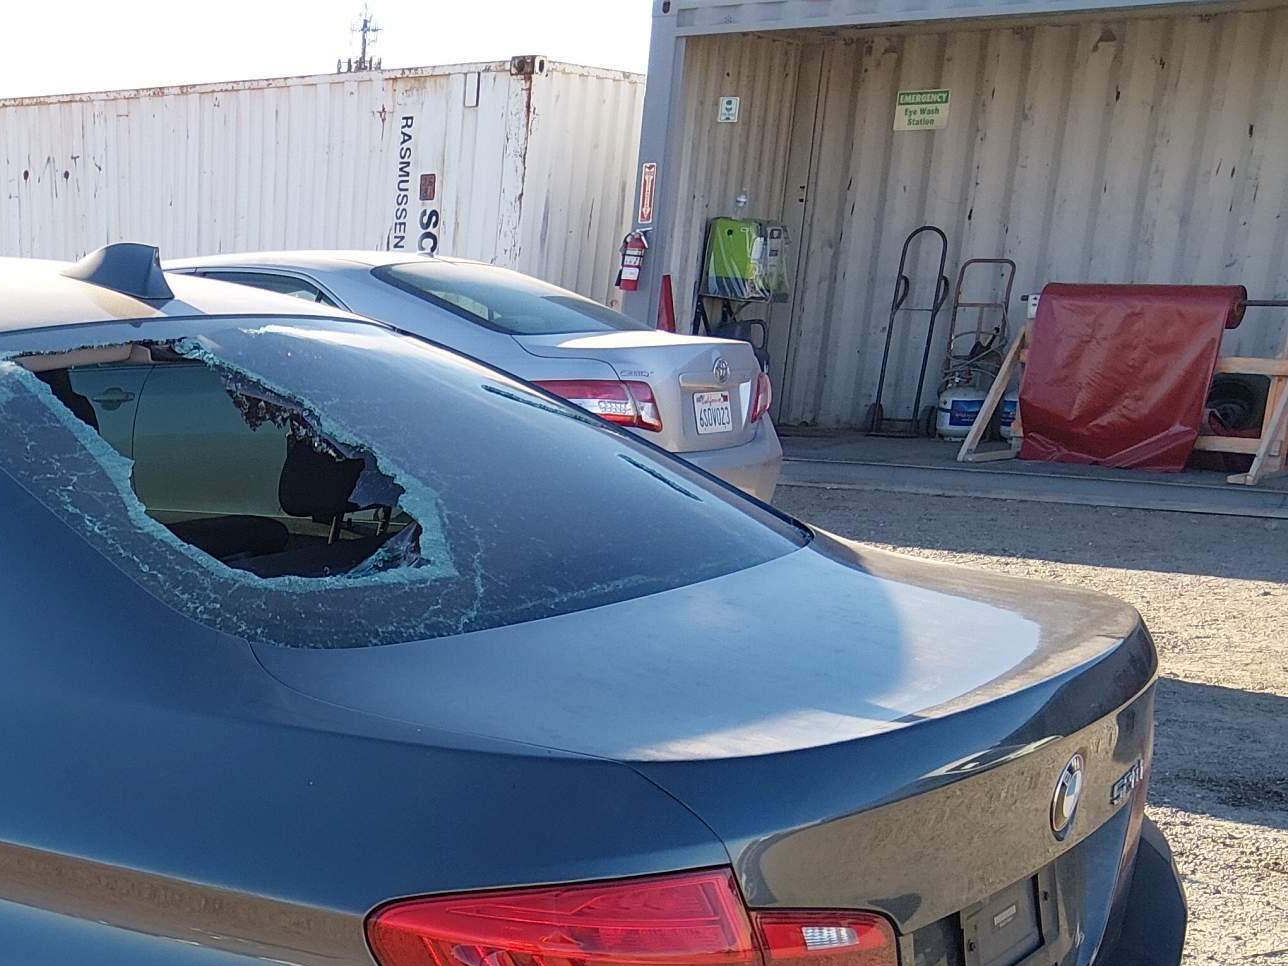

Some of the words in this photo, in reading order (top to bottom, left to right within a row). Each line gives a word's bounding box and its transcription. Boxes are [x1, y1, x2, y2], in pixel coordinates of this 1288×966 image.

[900, 93, 948, 104] EMERGENCY
[904, 108, 917, 117] Eye
[919, 106, 940, 115] Wash
[907, 118, 934, 126] Station
[393, 115, 414, 249] RASMUSSEN
[418, 208, 439, 257] SC
